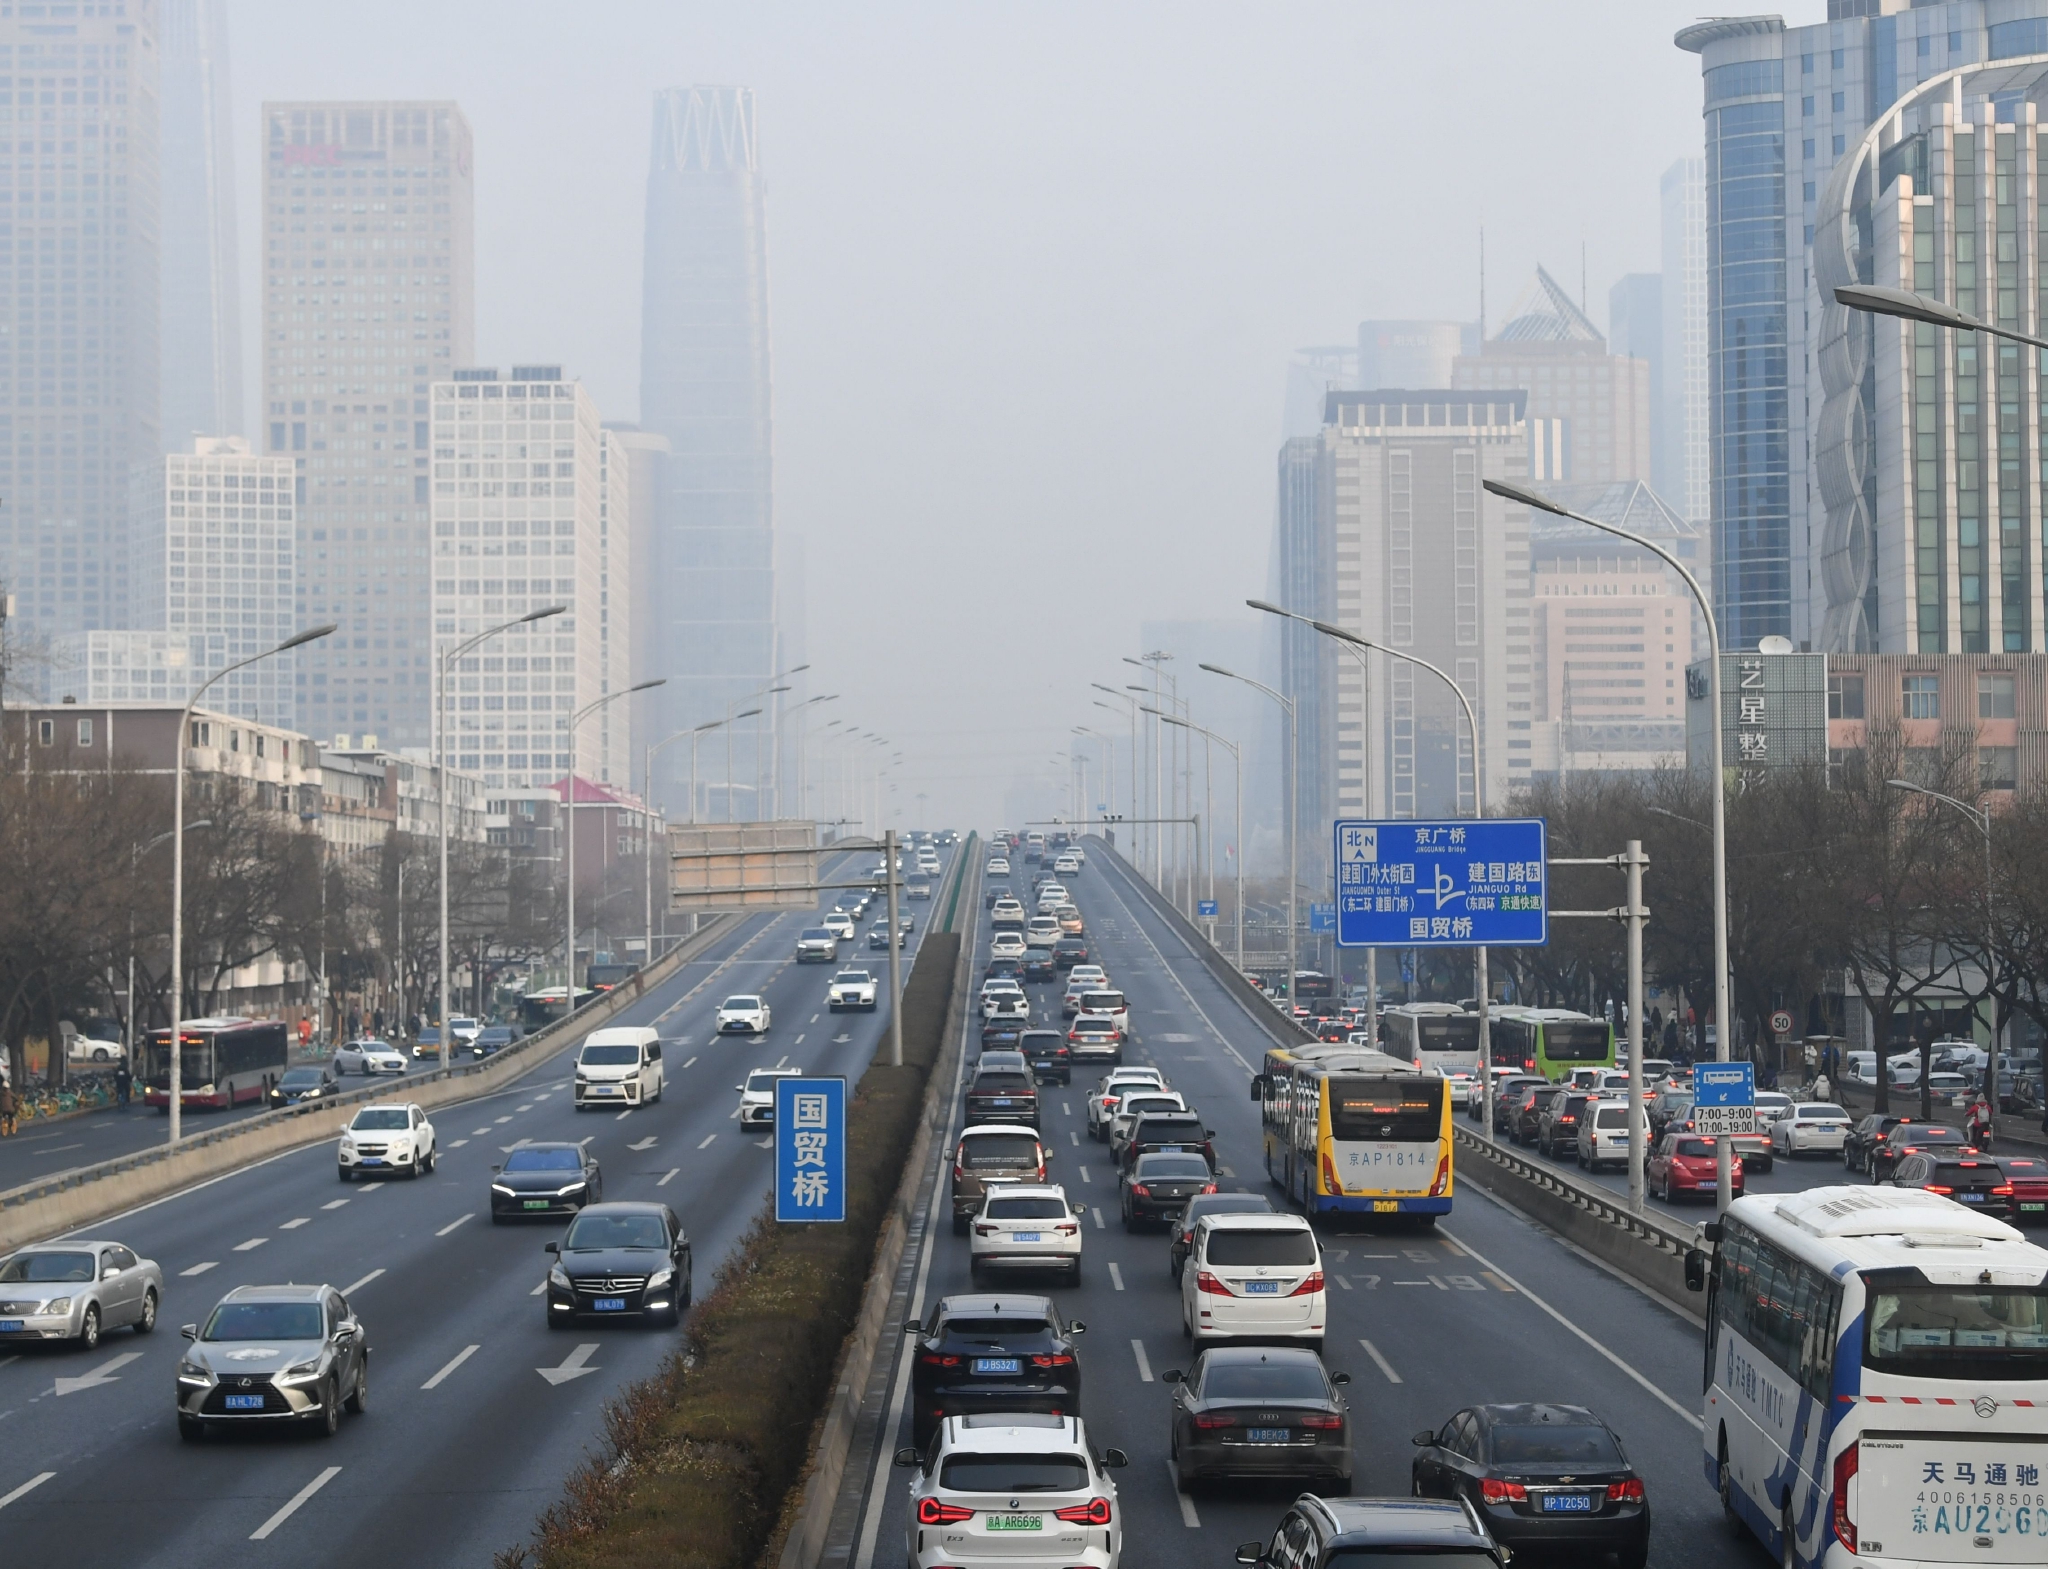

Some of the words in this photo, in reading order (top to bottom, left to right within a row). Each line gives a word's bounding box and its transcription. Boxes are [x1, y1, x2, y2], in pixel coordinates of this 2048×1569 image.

[1347, 831, 1362, 847] 北
[1365, 836, 1374, 847] N
[1415, 827, 1466, 845] 京广桥
[1448, 845, 1467, 855] Bridge
[1376, 886, 1392, 895] Outer
[1394, 886, 1401, 895] St
[1468, 885, 1510, 894] JIANGUO
[1515, 885, 1527, 893] Rd
[1410, 916, 1473, 939] 国贸桥
[1774, 1017, 1789, 1029] 50
[1697, 1108, 1752, 1120] 7:00-9:00
[1698, 1121, 1753, 1134] 17:00-19:00
[792, 1094, 829, 1207] 国贸桥
[1349, 1152, 1426, 1167] 京AP1814
[1761, 1377, 1784, 1429] TMTC
[1922, 1462, 2039, 1486] 天马通驰
[1916, 1491, 2045, 1507] 4006158506
